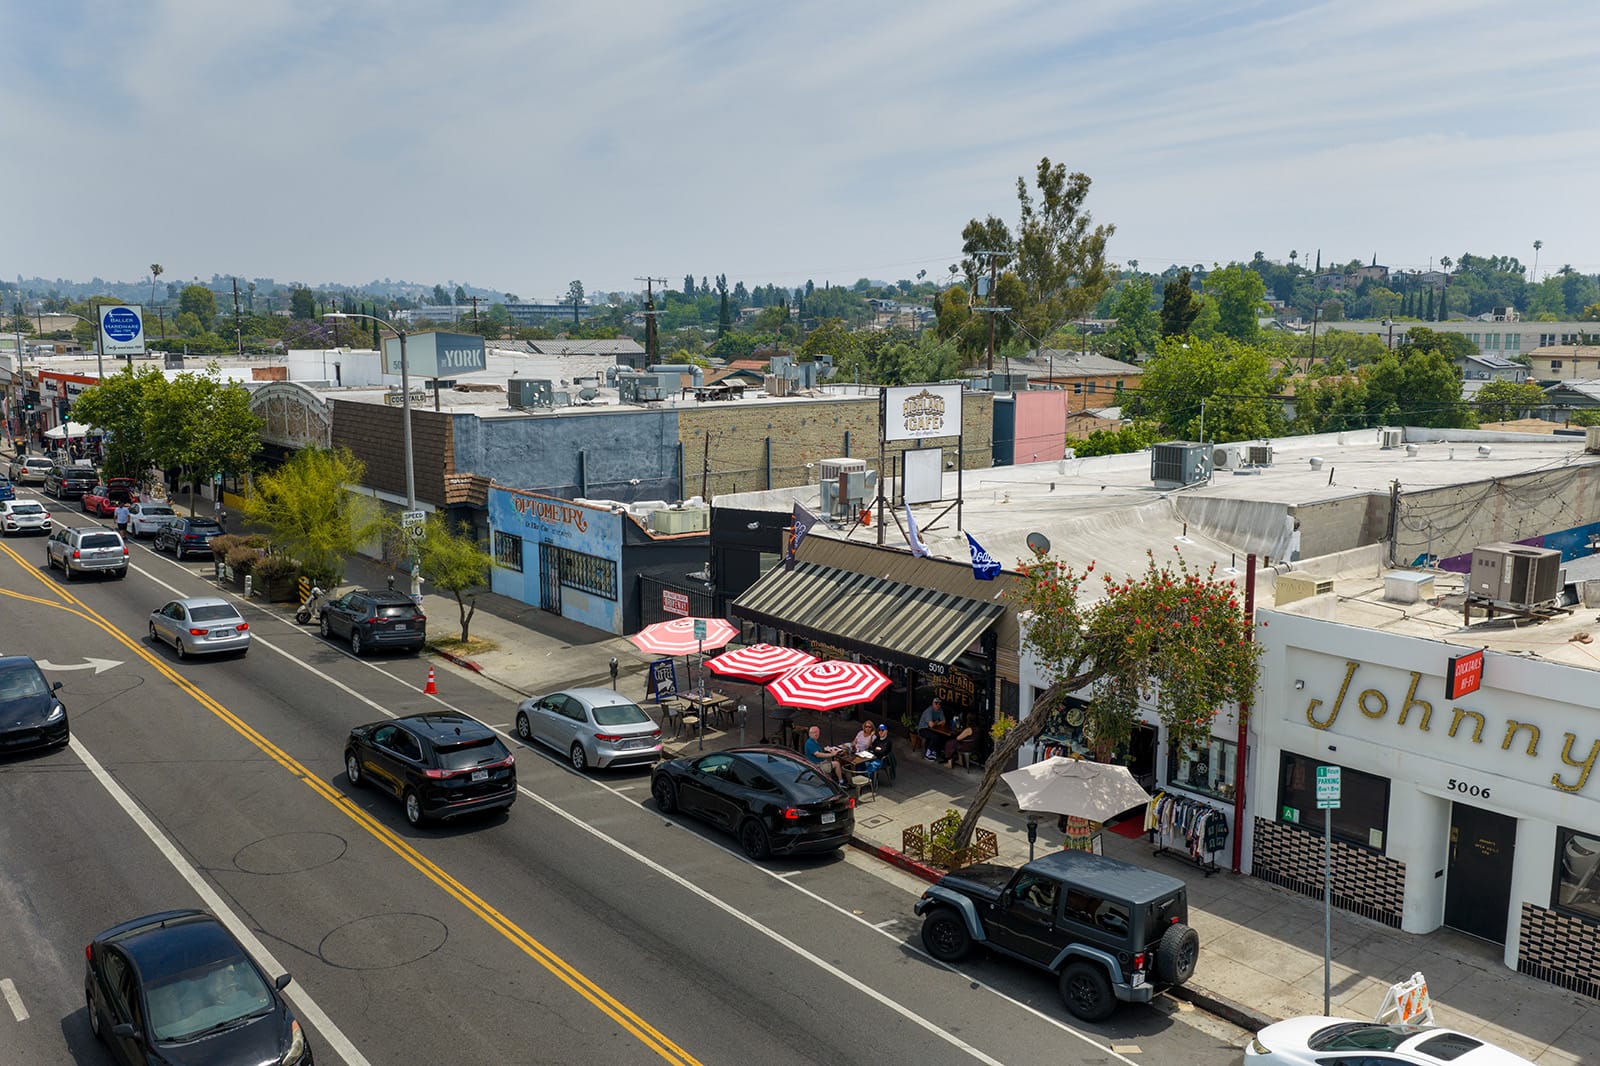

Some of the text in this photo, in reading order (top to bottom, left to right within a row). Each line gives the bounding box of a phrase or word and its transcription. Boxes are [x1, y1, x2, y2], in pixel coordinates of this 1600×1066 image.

[445, 349, 482, 367] YORK
[391, 394, 425, 403] COCTAILS
[903, 398, 945, 414] HIGHLAND
[909, 416, 940, 431] CAFE
[404, 511, 424, 519] SPEED
[515, 497, 588, 533] OPTOMETRY
[928, 662, 945, 675] 5010
[1455, 656, 1482, 677] COCKTAILS
[1460, 674, 1475, 690] HI-FI
[1306, 661, 1600, 792] Johnny
[1317, 777, 1340, 785] PARKING
[1447, 778, 1491, 799] 5006
[1285, 809, 1293, 819] A
